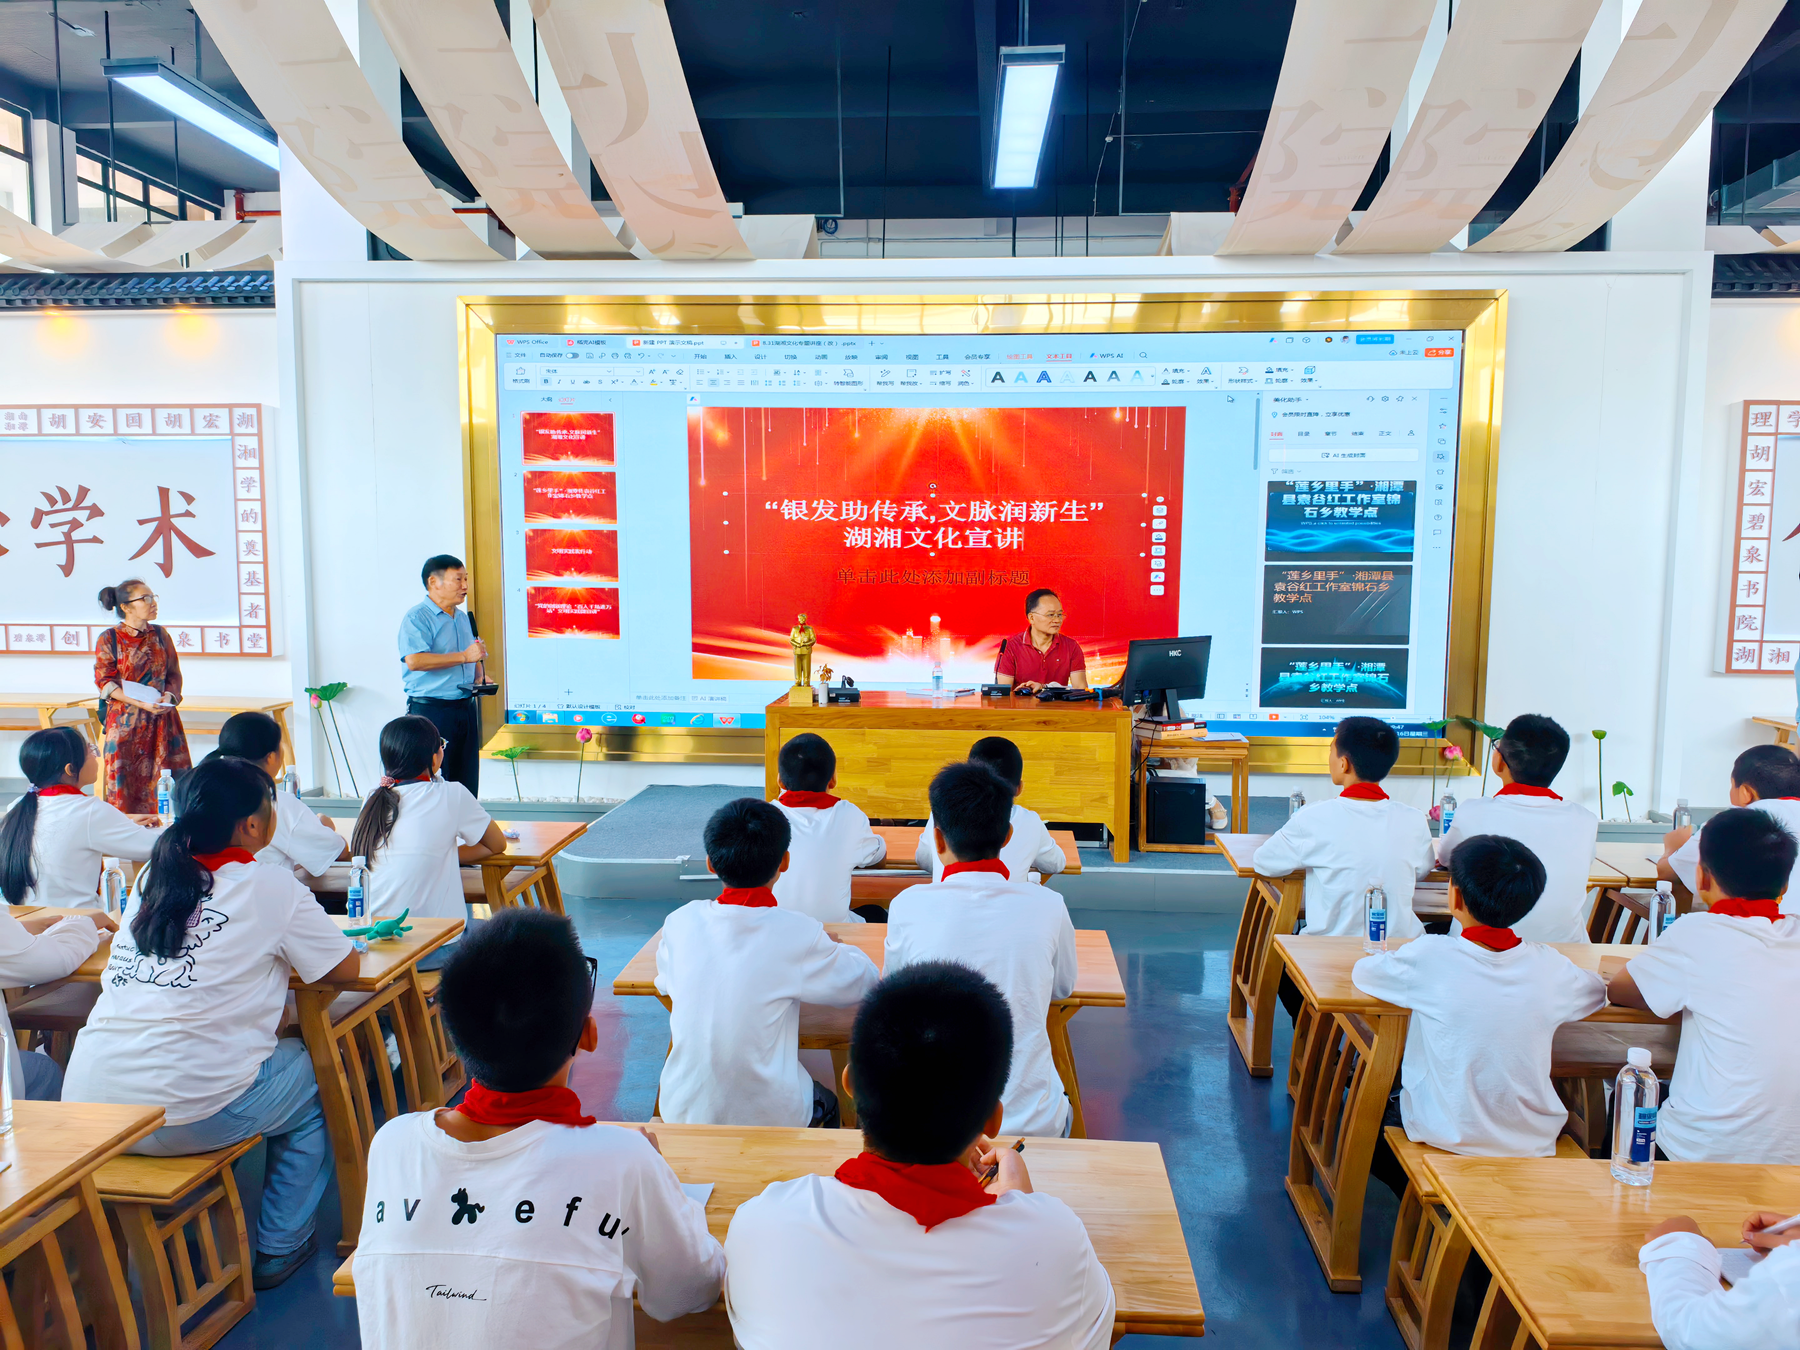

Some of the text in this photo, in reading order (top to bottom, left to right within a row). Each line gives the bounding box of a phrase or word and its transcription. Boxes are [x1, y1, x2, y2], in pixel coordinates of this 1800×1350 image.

[1282, 494, 1401, 506] 县袁谷红工作室锦
[1304, 507, 1378, 518] 石乡教学点
[0, 484, 216, 579] 学术
[843, 528, 1022, 550] 湖湘文化宣讲
[838, 568, 1030, 586] 单击此处添加副标题
[1274, 582, 1390, 592] 袁谷红工作室锦石乡
[1273, 593, 1312, 604] 教学点
[1308, 683, 1358, 693] 乡教学点
[426, 1284, 487, 1302] Tailwind
